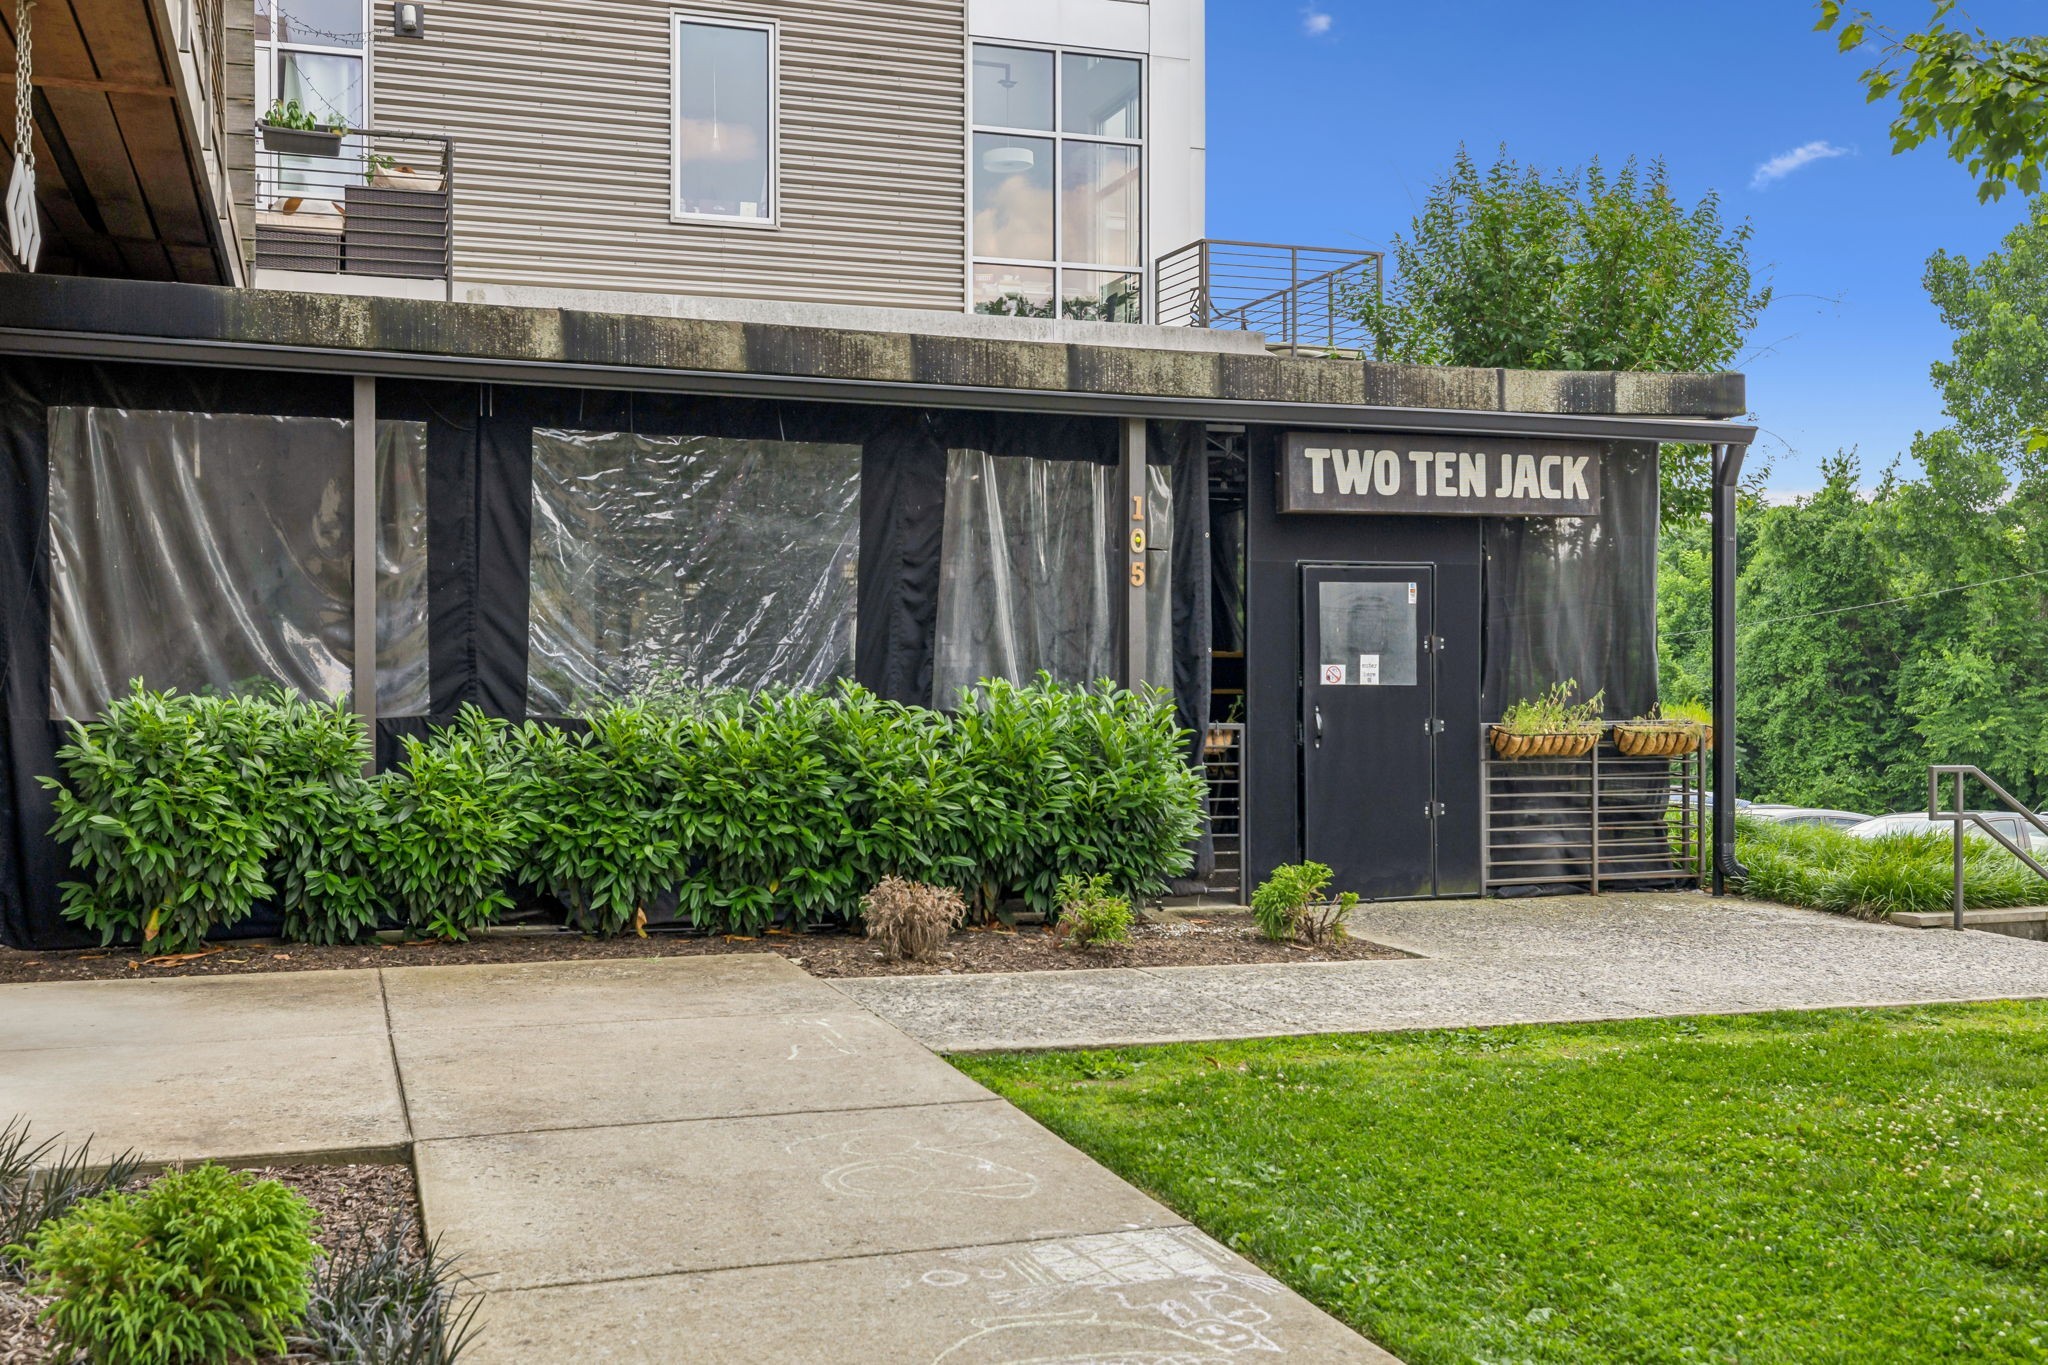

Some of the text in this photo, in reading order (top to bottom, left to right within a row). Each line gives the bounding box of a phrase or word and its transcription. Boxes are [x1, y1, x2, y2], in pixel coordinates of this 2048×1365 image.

[1304, 448, 1589, 499] TWO TEN JACK
[1130, 495, 1145, 587] 105
